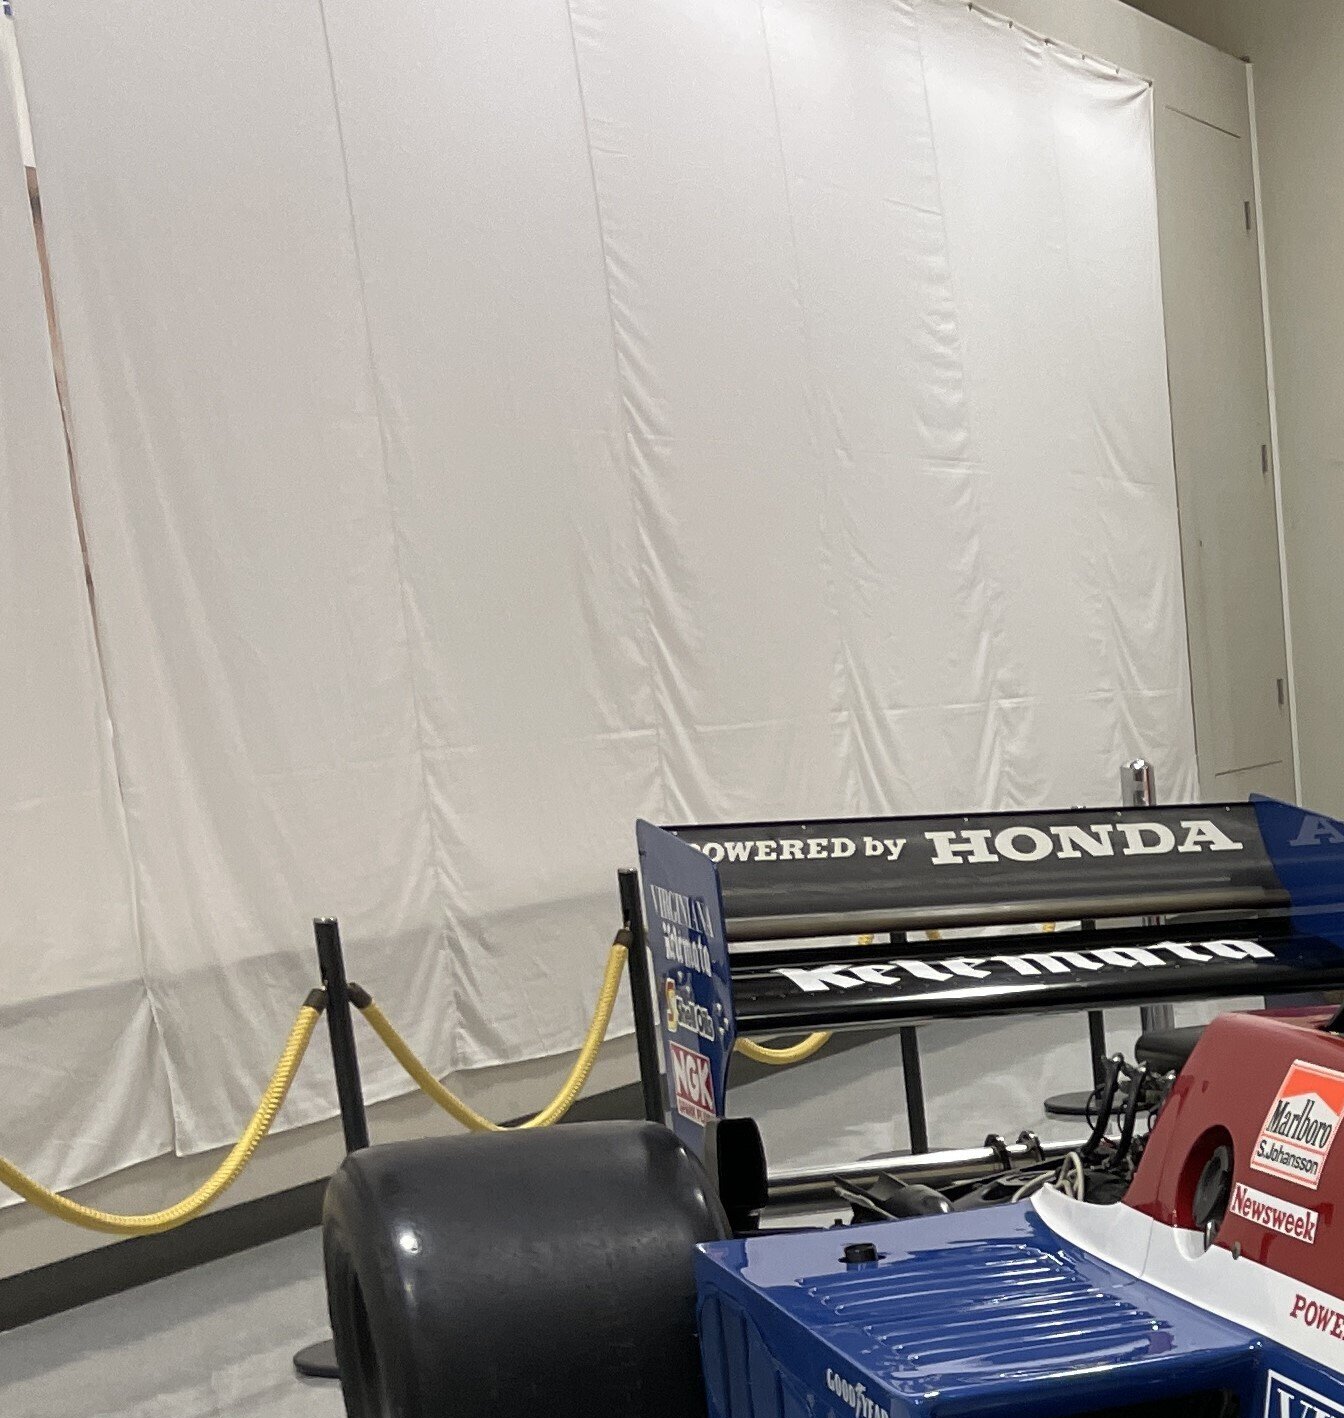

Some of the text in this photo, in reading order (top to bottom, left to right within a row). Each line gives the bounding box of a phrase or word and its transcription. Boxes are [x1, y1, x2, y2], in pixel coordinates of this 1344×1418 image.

[690, 820, 1243, 865] OWERED by HONDA
[672, 1048, 714, 1111] NGK
[1266, 1099, 1333, 1149] Marlboro
[1256, 1139, 1319, 1176] S.Johansson
[1231, 1185, 1316, 1242] Newsweek
